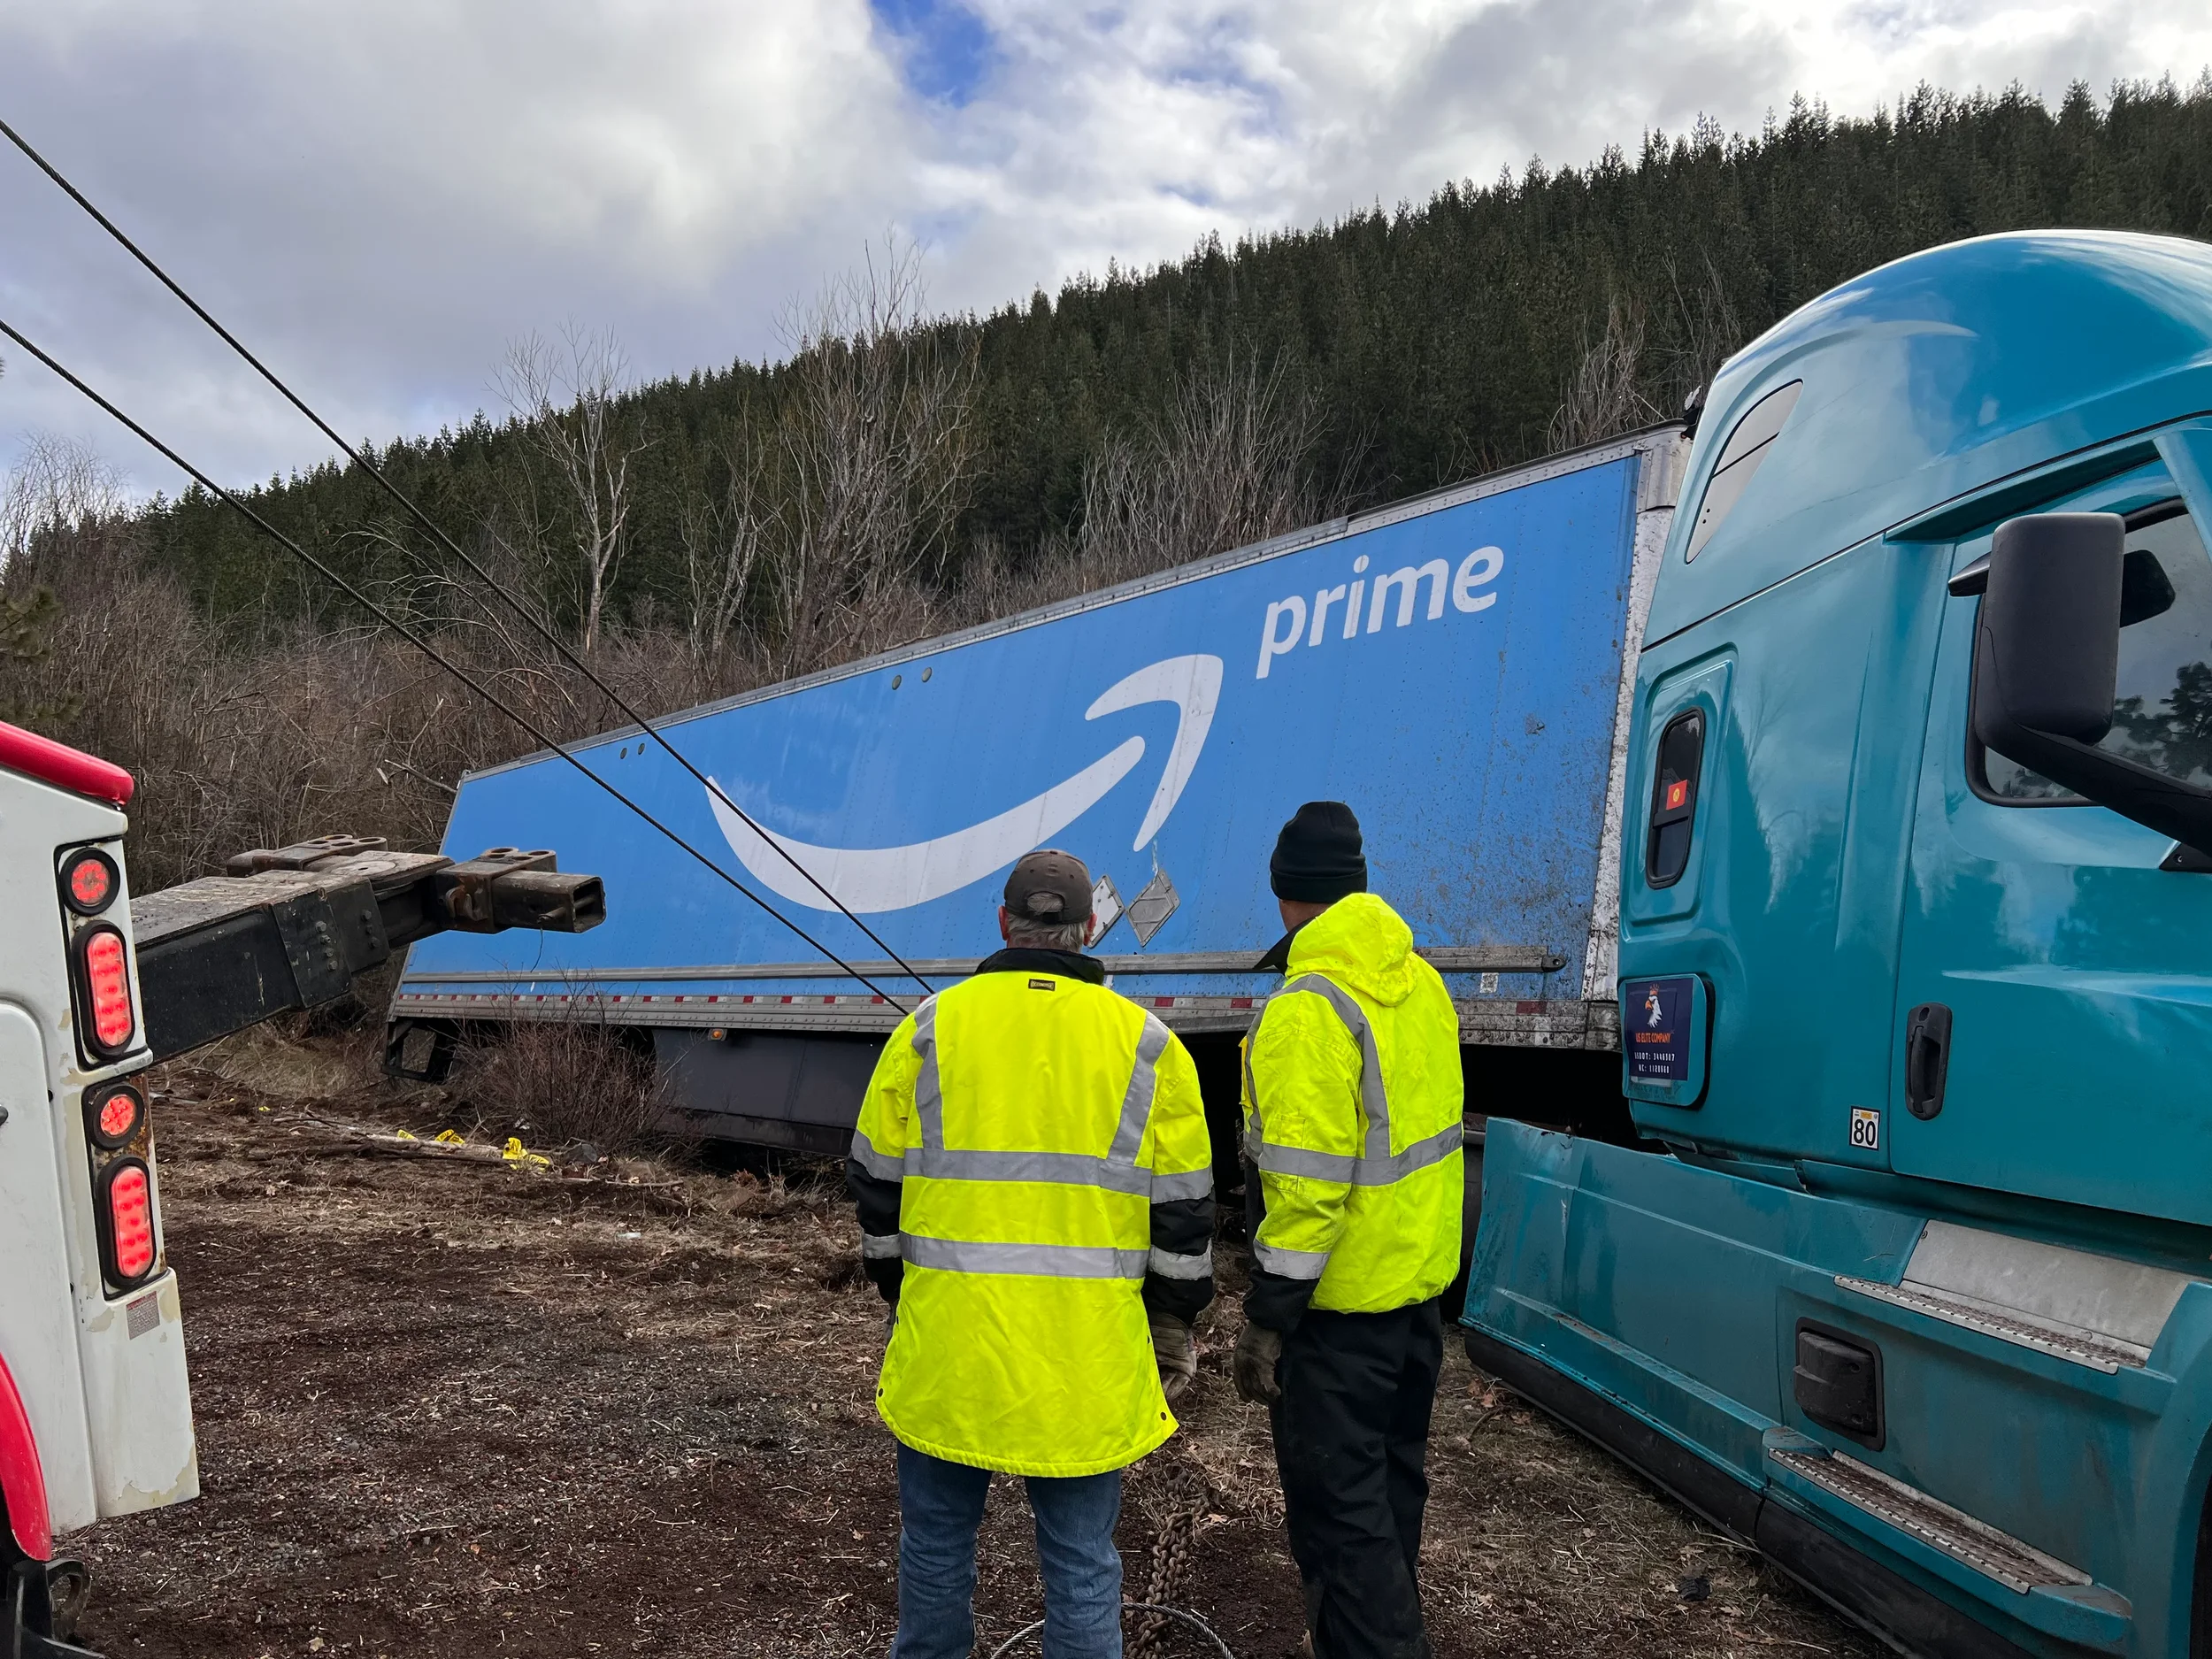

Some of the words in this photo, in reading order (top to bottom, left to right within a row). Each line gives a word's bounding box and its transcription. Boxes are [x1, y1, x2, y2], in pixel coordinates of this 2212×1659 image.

[1256, 546, 1504, 680] prime
[1651, 1033, 1671, 1043] COMPANY
[1854, 1119, 1876, 1146] 80
